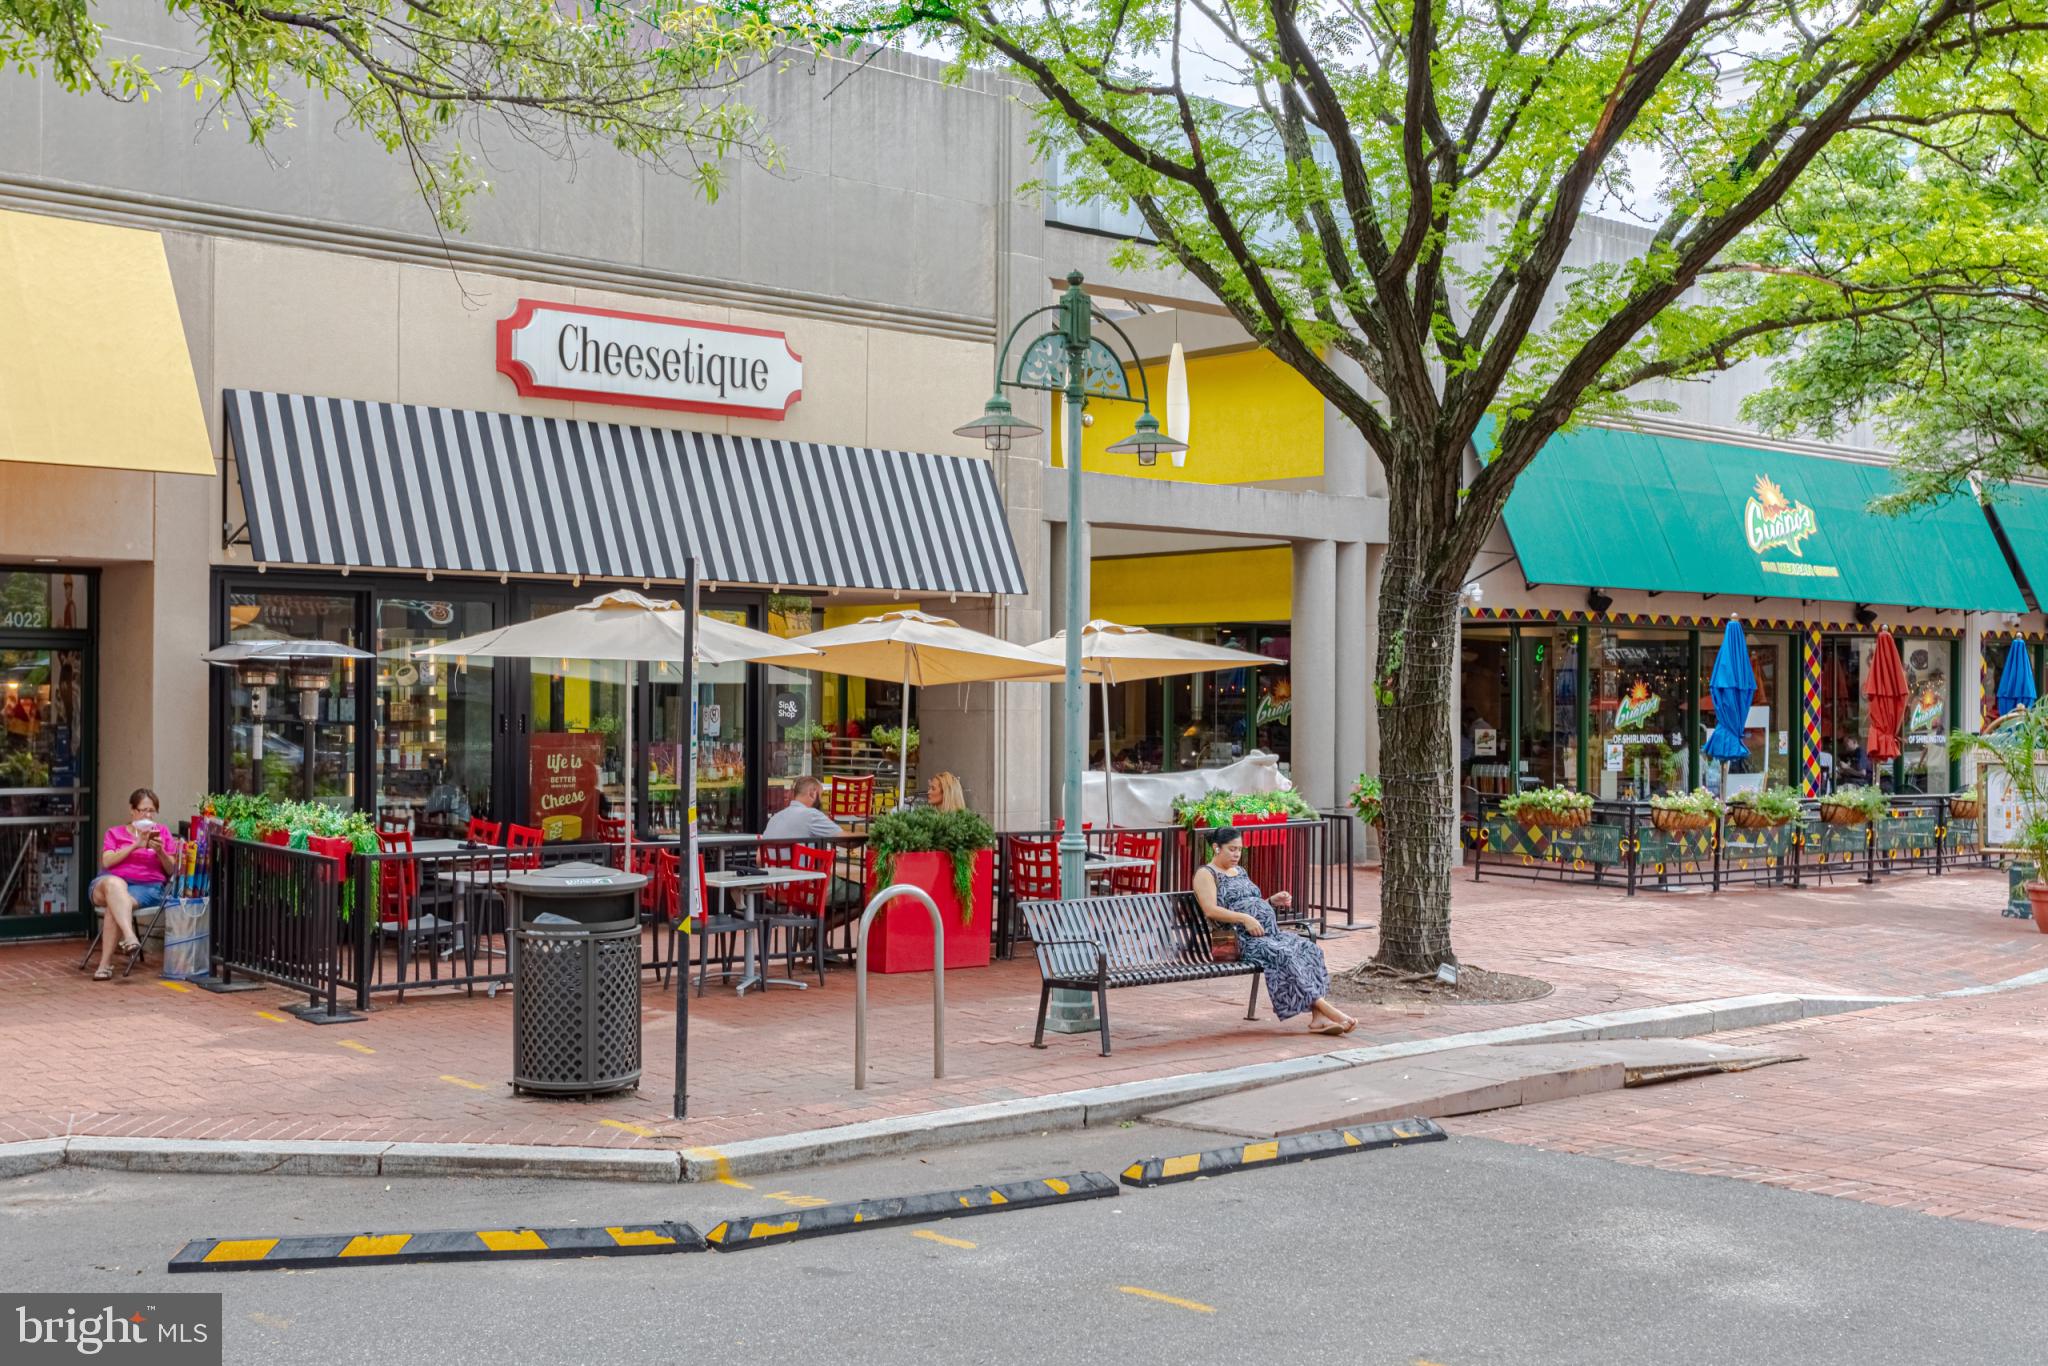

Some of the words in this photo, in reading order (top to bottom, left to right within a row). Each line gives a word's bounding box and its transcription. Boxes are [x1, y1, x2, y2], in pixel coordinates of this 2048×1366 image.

[558, 323, 768, 399] Cheesetique
[4, 611, 42, 628] 4022
[779, 709, 796, 719] Shop
[1613, 734, 1621, 743] OF
[1622, 734, 1664, 744] SHIRLINGTON
[571, 754, 583, 769] is
[541, 790, 586, 810] Cheese
